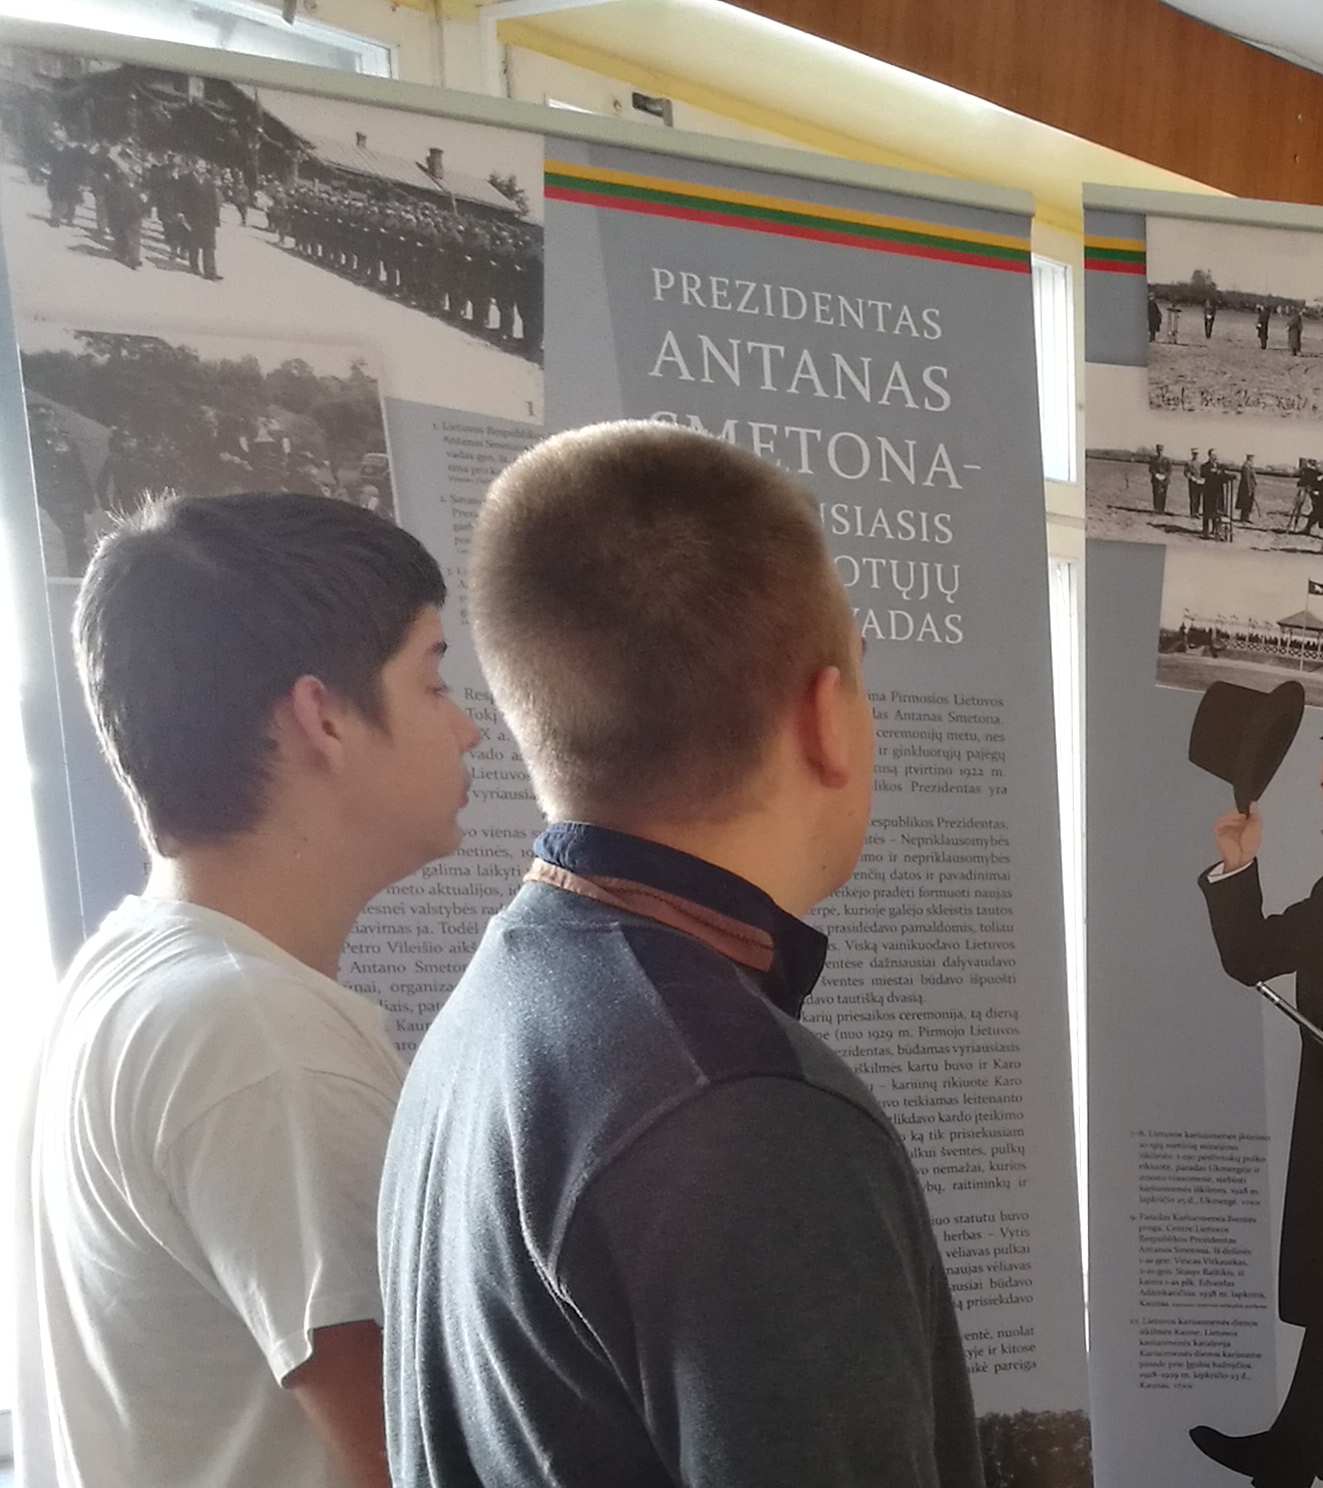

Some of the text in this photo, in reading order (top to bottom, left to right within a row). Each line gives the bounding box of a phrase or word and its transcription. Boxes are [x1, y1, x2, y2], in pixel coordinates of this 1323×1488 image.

[651, 268, 942, 339] PREZIDENTAS
[649, 330, 951, 411] ANTANAS
[818, 504, 953, 543] SIASIS
[835, 555, 960, 603] OTŲJŲ
[891, 690, 1004, 707] Pirmosios Lietuvos
[894, 709, 1004, 724] Antanas Smetona.
[876, 728, 1006, 742] ceremonijų metu, nes
[959, 768, 984, 778] 1922
[911, 780, 1008, 797] Prezidentas yra
[482, 826, 527, 838] vienas
[901, 833, 1010, 849] Nepriklausomybės
[903, 852, 1011, 867] nepriklausomybės
[422, 863, 521, 879] galima laikyti
[890, 870, 1011, 885] datos pavadinimai
[428, 882, 504, 899] aktualijos,
[873, 887, 1013, 901] pradėti formuoti naujas
[410, 902, 478, 919] valstybės
[844, 904, 886, 918] kurioje
[976, 906, 1013, 916] tautos
[438, 921, 479, 935] Todėl
[979, 922, 1014, 933] toliau
[387, 941, 444, 955] Vileišio
[845, 939, 1015, 954] Viską vainikuodavo Lietuvos
[870, 957, 1016, 971] dažniausiai dalyvaudavo
[820, 974, 1016, 987] šventes miestai būdavo išpuošti
[837, 992, 884, 1006] tautišką
[837, 1011, 896, 1025] priesaikos
[985, 1008, 1019, 1021] dieną
[918, 1025, 1020, 1040] Pirmojo Lietuvos
